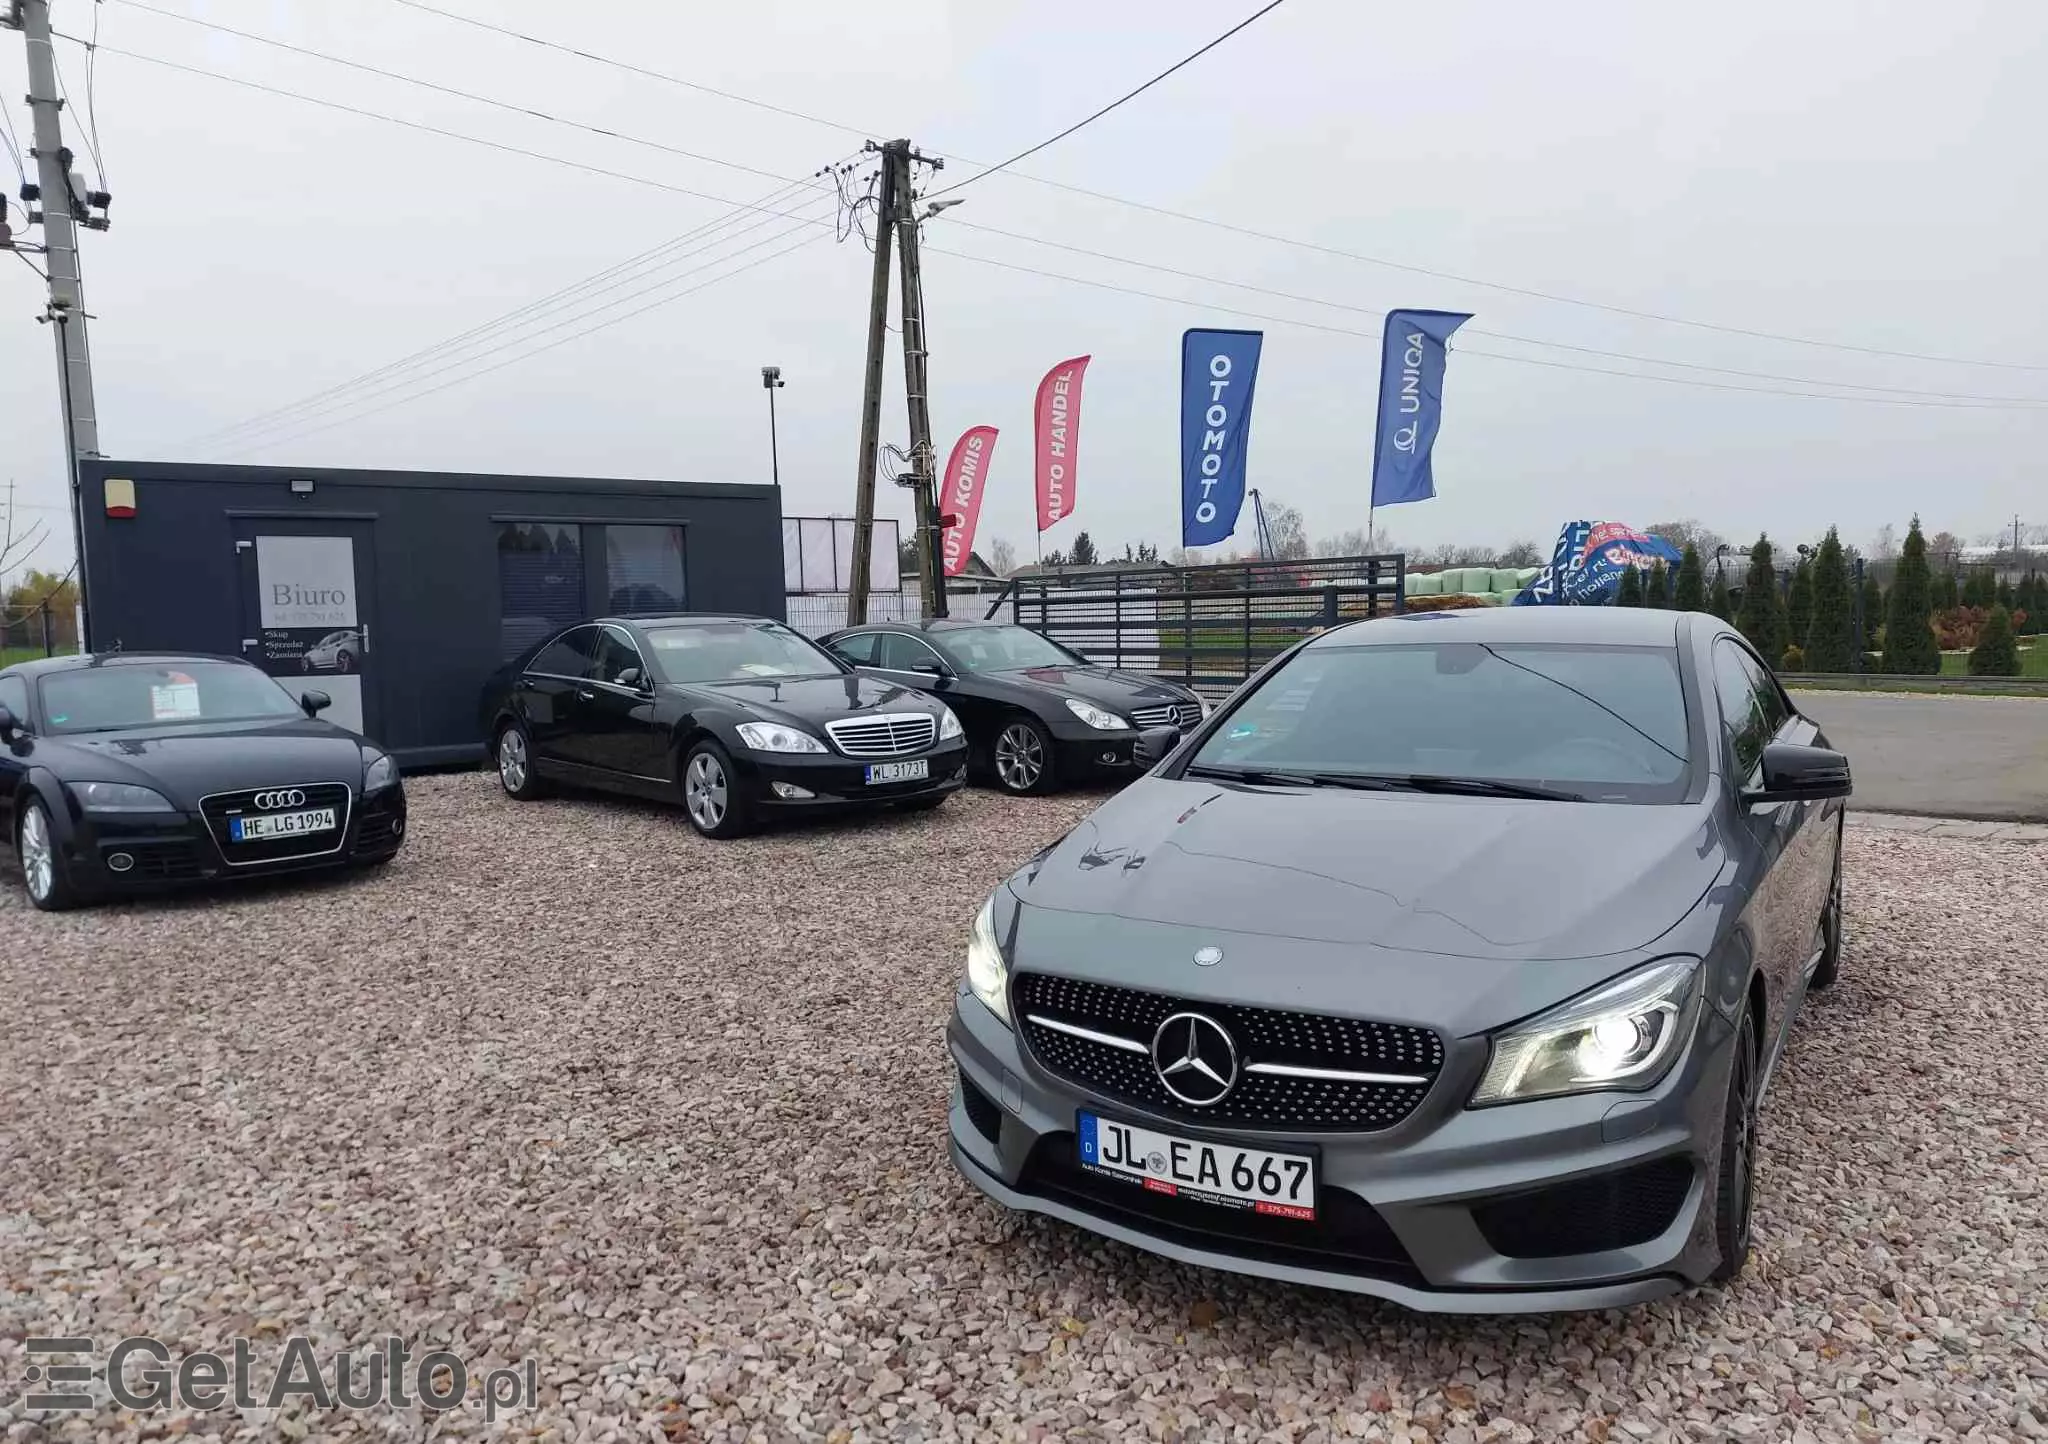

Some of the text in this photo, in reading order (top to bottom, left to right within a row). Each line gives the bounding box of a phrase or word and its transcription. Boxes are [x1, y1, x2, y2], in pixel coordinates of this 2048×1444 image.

[1400, 332, 1425, 414] UNIQA
[1047, 370, 1073, 521] AUTO HANDEL
[1195, 354, 1232, 523] OTOMOTO
[944, 435, 984, 572] AUTO KOMIS
[272, 583, 346, 606] Biuro
[873, 760, 925, 779] WL 3173T
[243, 811, 333, 836] HE LG 1994
[1085, 1142, 1092, 1154] D
[1102, 1125, 1309, 1200] JL EA 667
